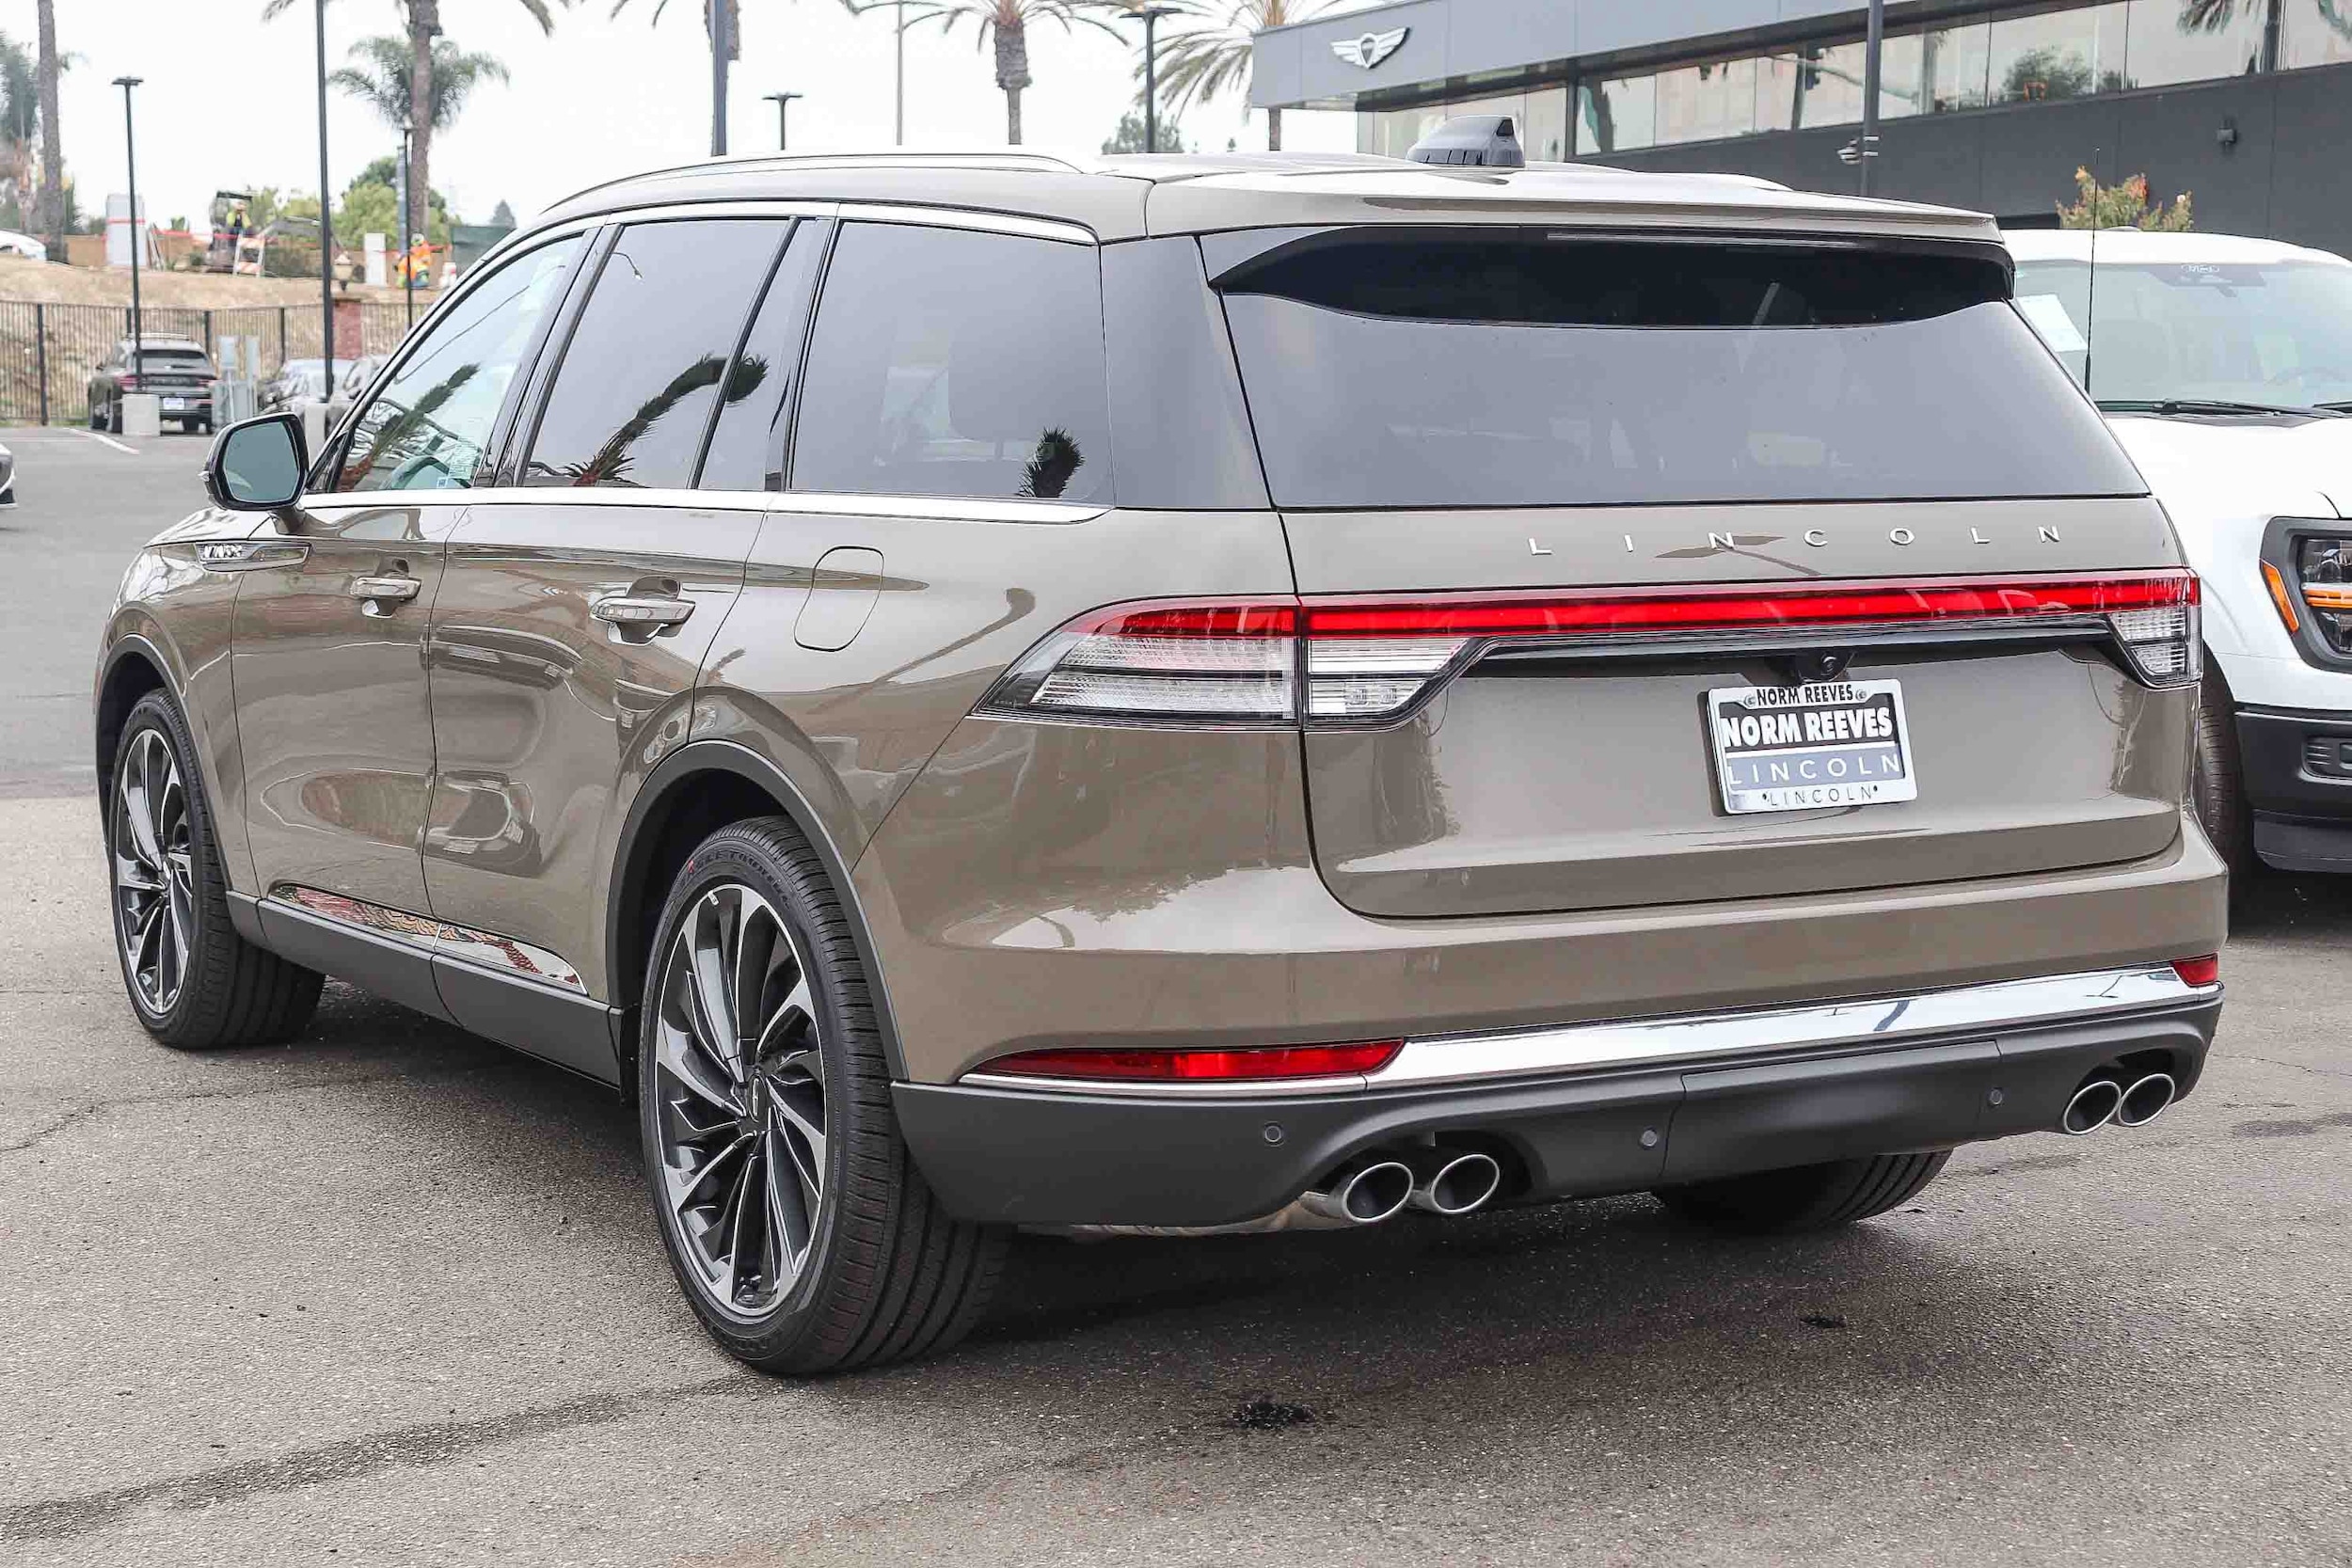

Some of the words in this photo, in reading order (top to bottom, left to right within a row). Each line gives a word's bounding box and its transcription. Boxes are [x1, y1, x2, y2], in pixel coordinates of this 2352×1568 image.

[1528, 525, 2060, 556] LINCOLN
[1756, 688, 1801, 706] NORM
[1805, 684, 1853, 703] REEVES
[1720, 712, 1803, 748] NORM
[1804, 707, 1894, 742] REEVES
[1727, 752, 1900, 785] LINCOLN
[1769, 785, 1871, 806] LINCOLN
